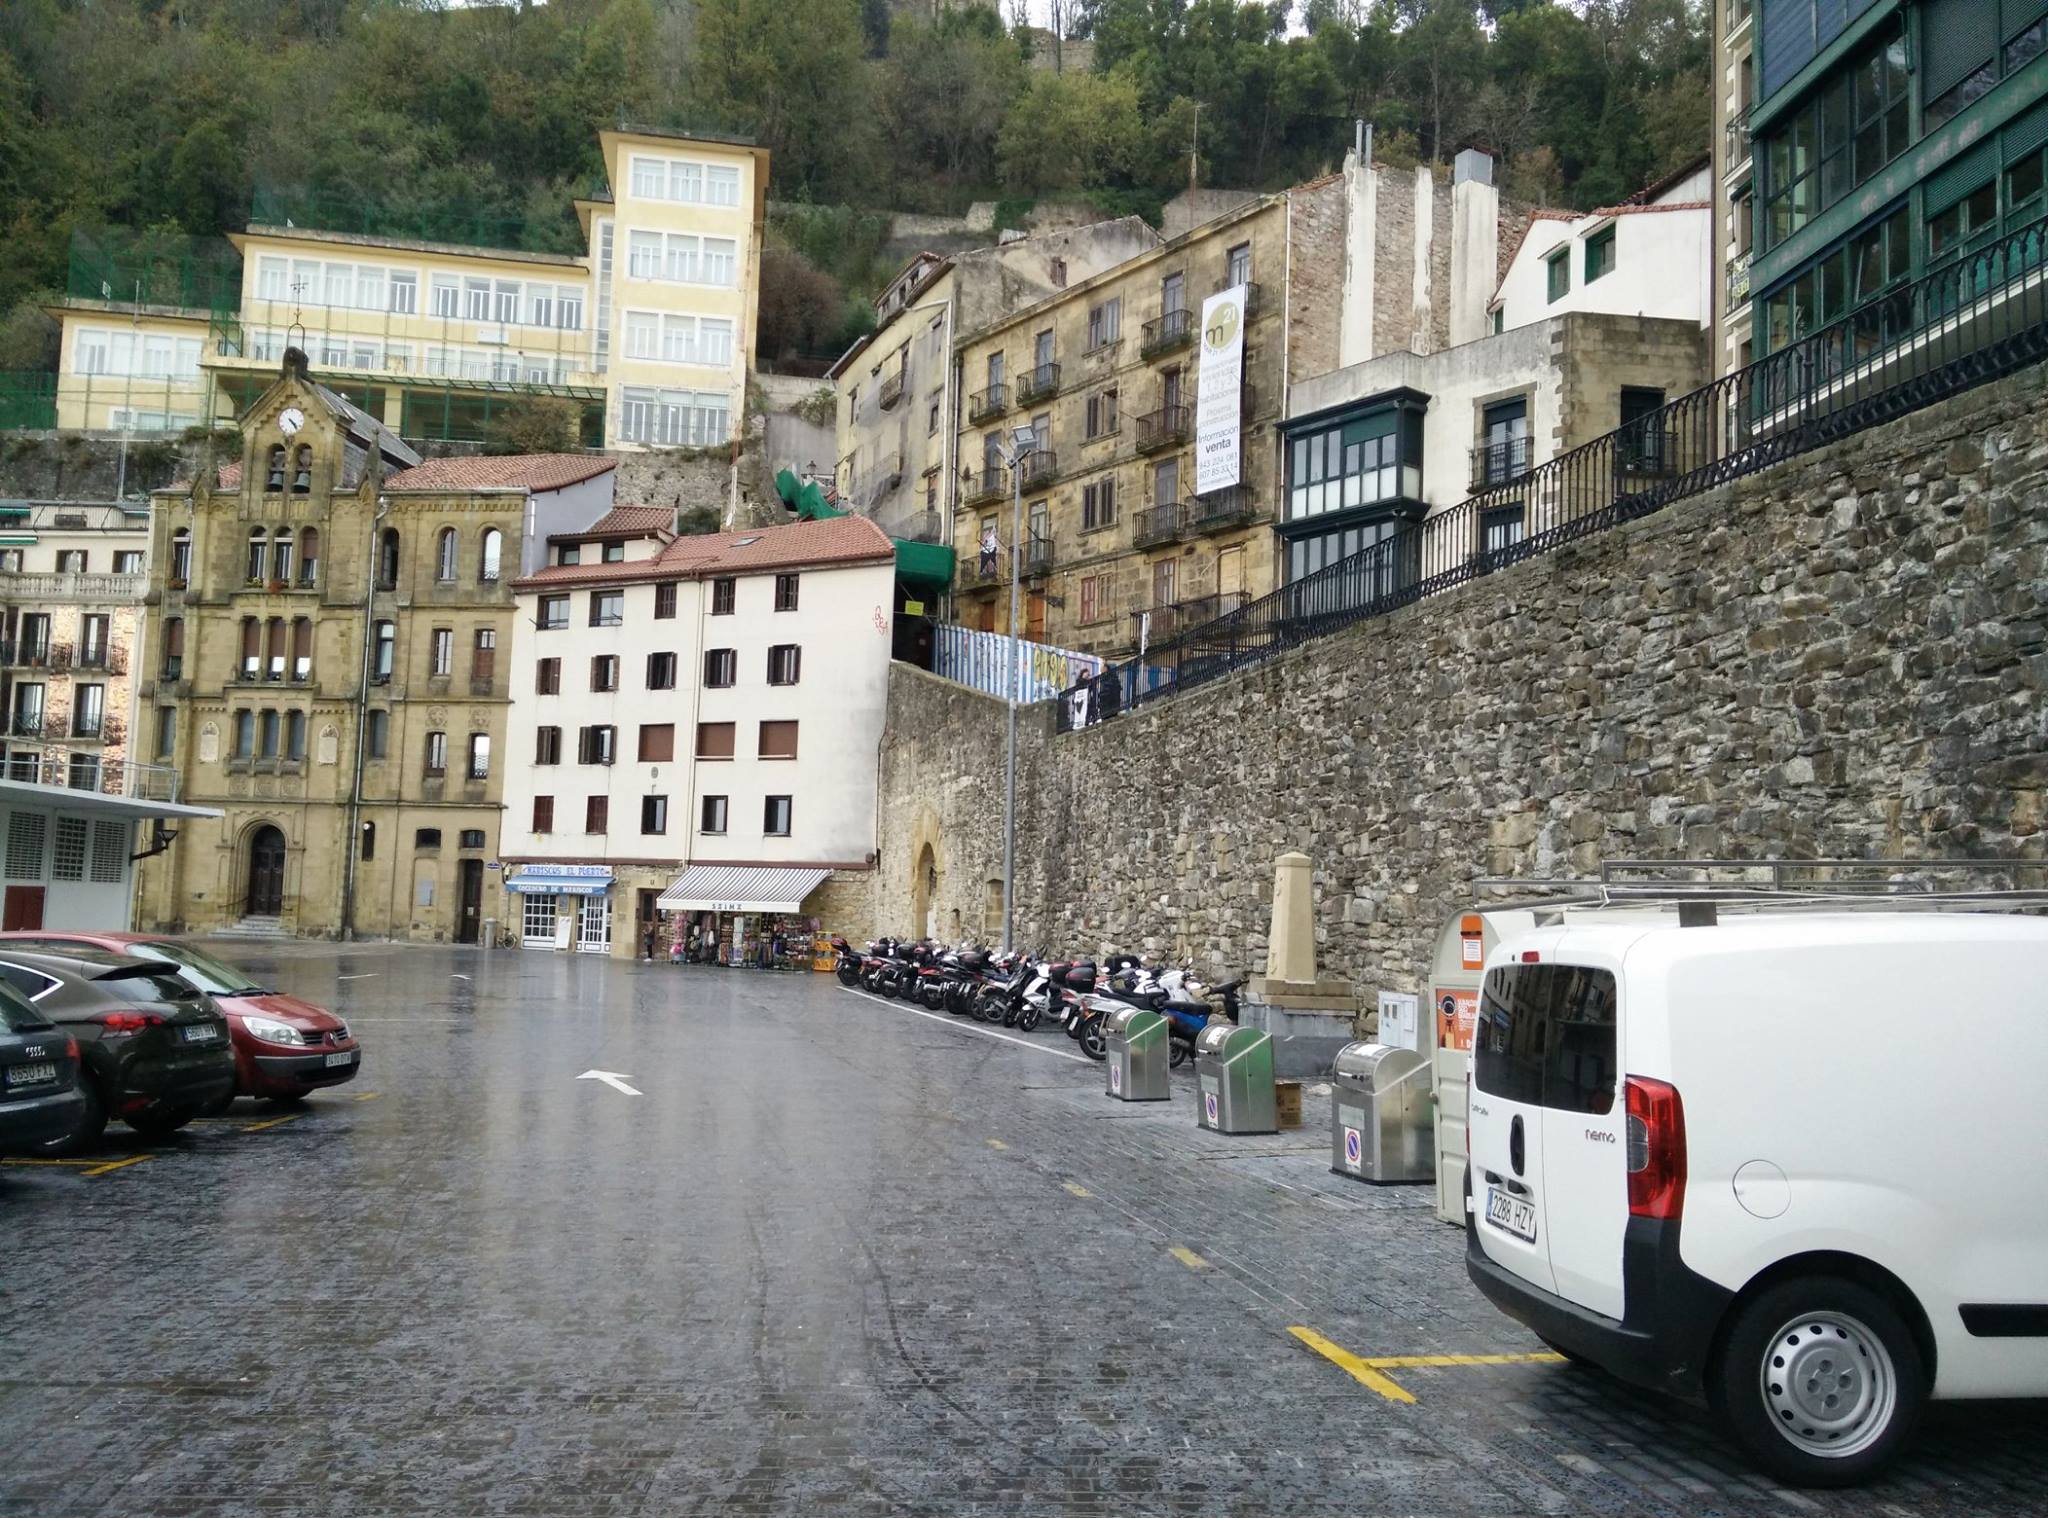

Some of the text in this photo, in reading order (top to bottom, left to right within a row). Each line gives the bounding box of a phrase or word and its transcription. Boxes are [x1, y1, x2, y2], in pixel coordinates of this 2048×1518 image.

[1223, 308, 1236, 323] 21
[1206, 326, 1223, 344] m
[1199, 425, 1239, 443] Información
[1205, 439, 1231, 453] venta
[567, 867, 577, 876] EL
[579, 867, 605, 876] PUERTO
[1585, 1129, 1616, 1143] nemo
[1492, 1195, 1534, 1233] 2288 HZY
